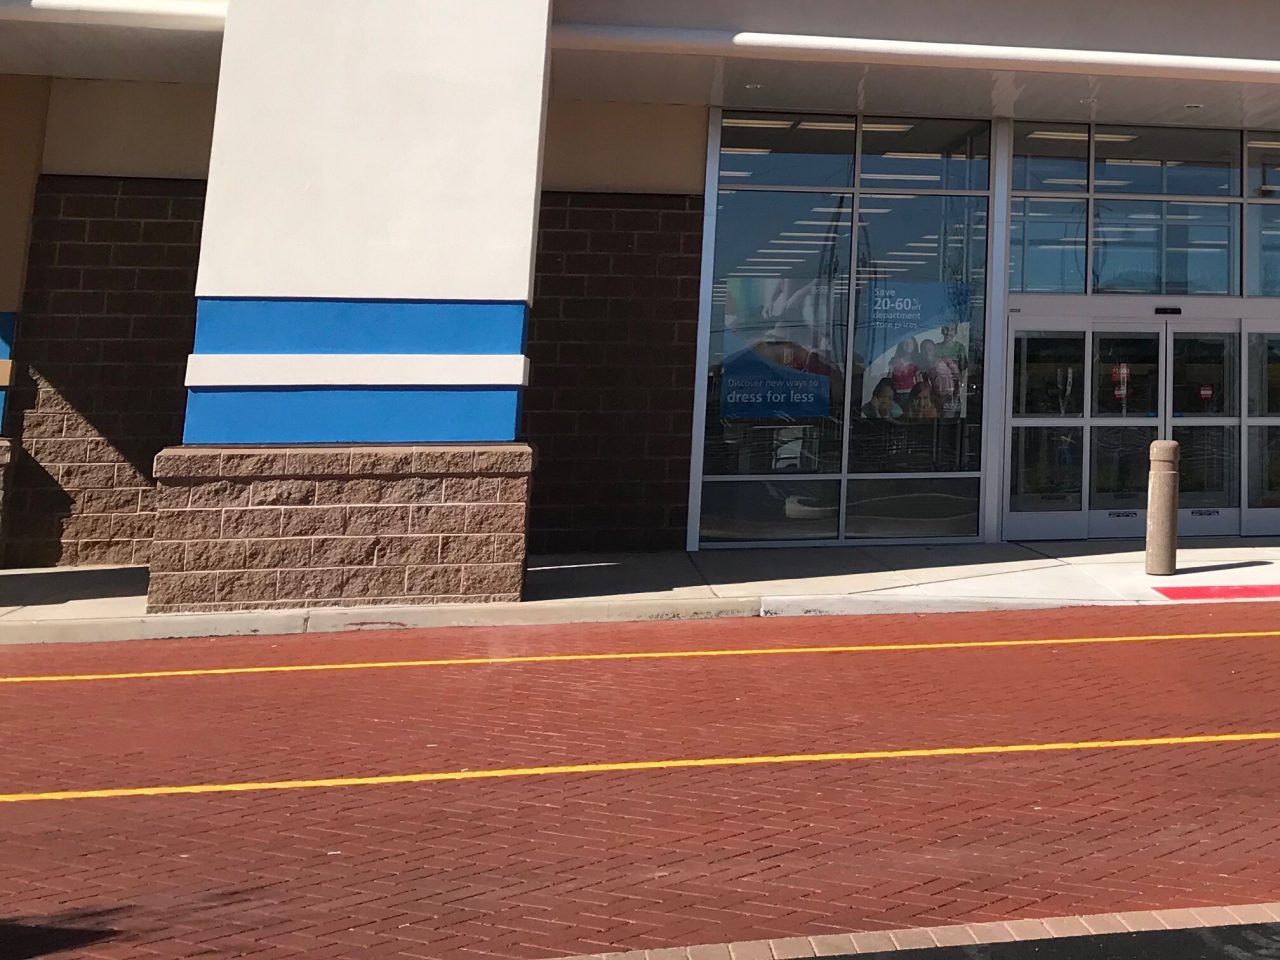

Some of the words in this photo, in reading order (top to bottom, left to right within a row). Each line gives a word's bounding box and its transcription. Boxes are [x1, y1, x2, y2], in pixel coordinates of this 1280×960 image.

[874, 287, 896, 297] Save
[873, 311, 921, 321] department
[765, 379, 784, 387] new
[786, 379, 808, 389] ways
[727, 390, 762, 402] dress
[766, 390, 787, 402] for
[790, 390, 815, 402] less
